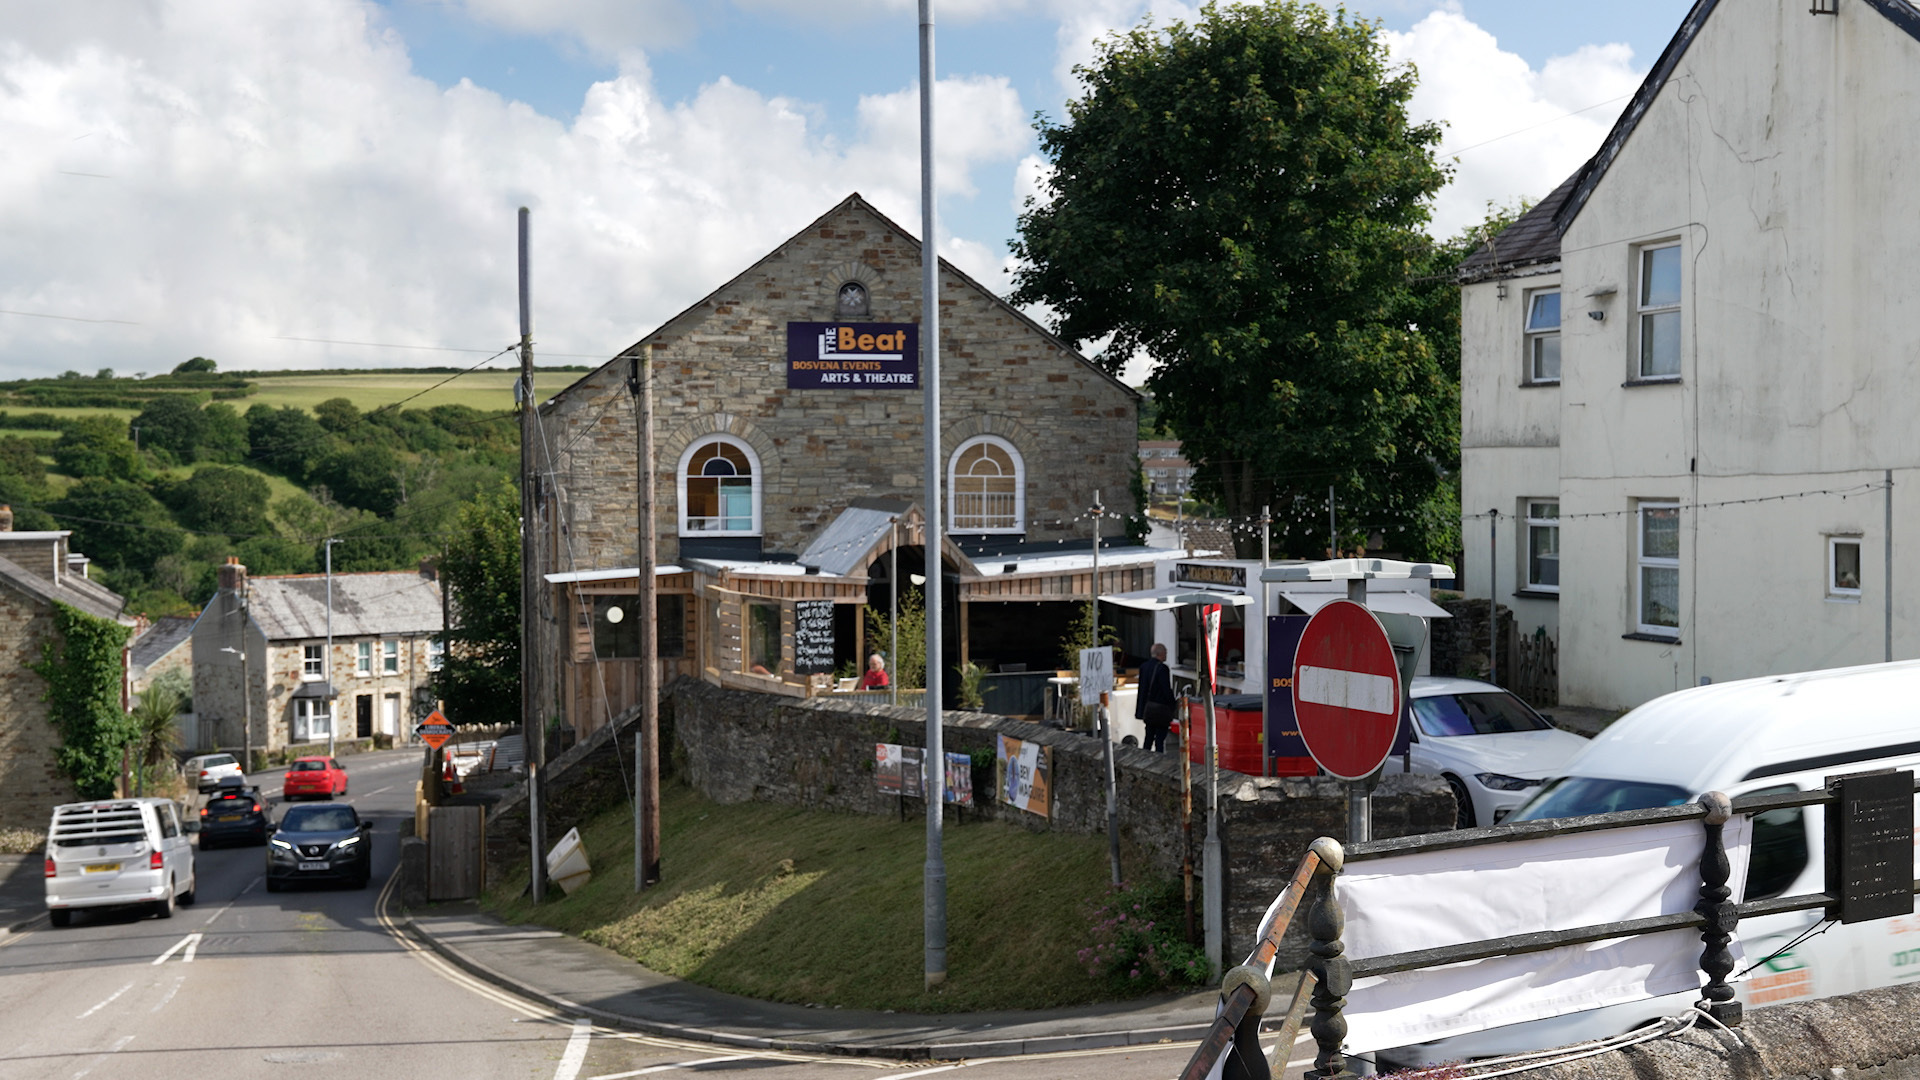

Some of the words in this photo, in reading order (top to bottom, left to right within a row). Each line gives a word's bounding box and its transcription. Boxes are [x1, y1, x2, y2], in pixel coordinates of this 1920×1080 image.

[825, 327, 837, 353] THE
[838, 327, 906, 351] Beat
[792, 361, 840, 370] BOSVENA
[842, 361, 882, 371] EVENTS
[820, 373, 851, 383] ARTS
[852, 373, 862, 383] &
[865, 373, 914, 384] THEATRE
[1086, 651, 1103, 671] NO
